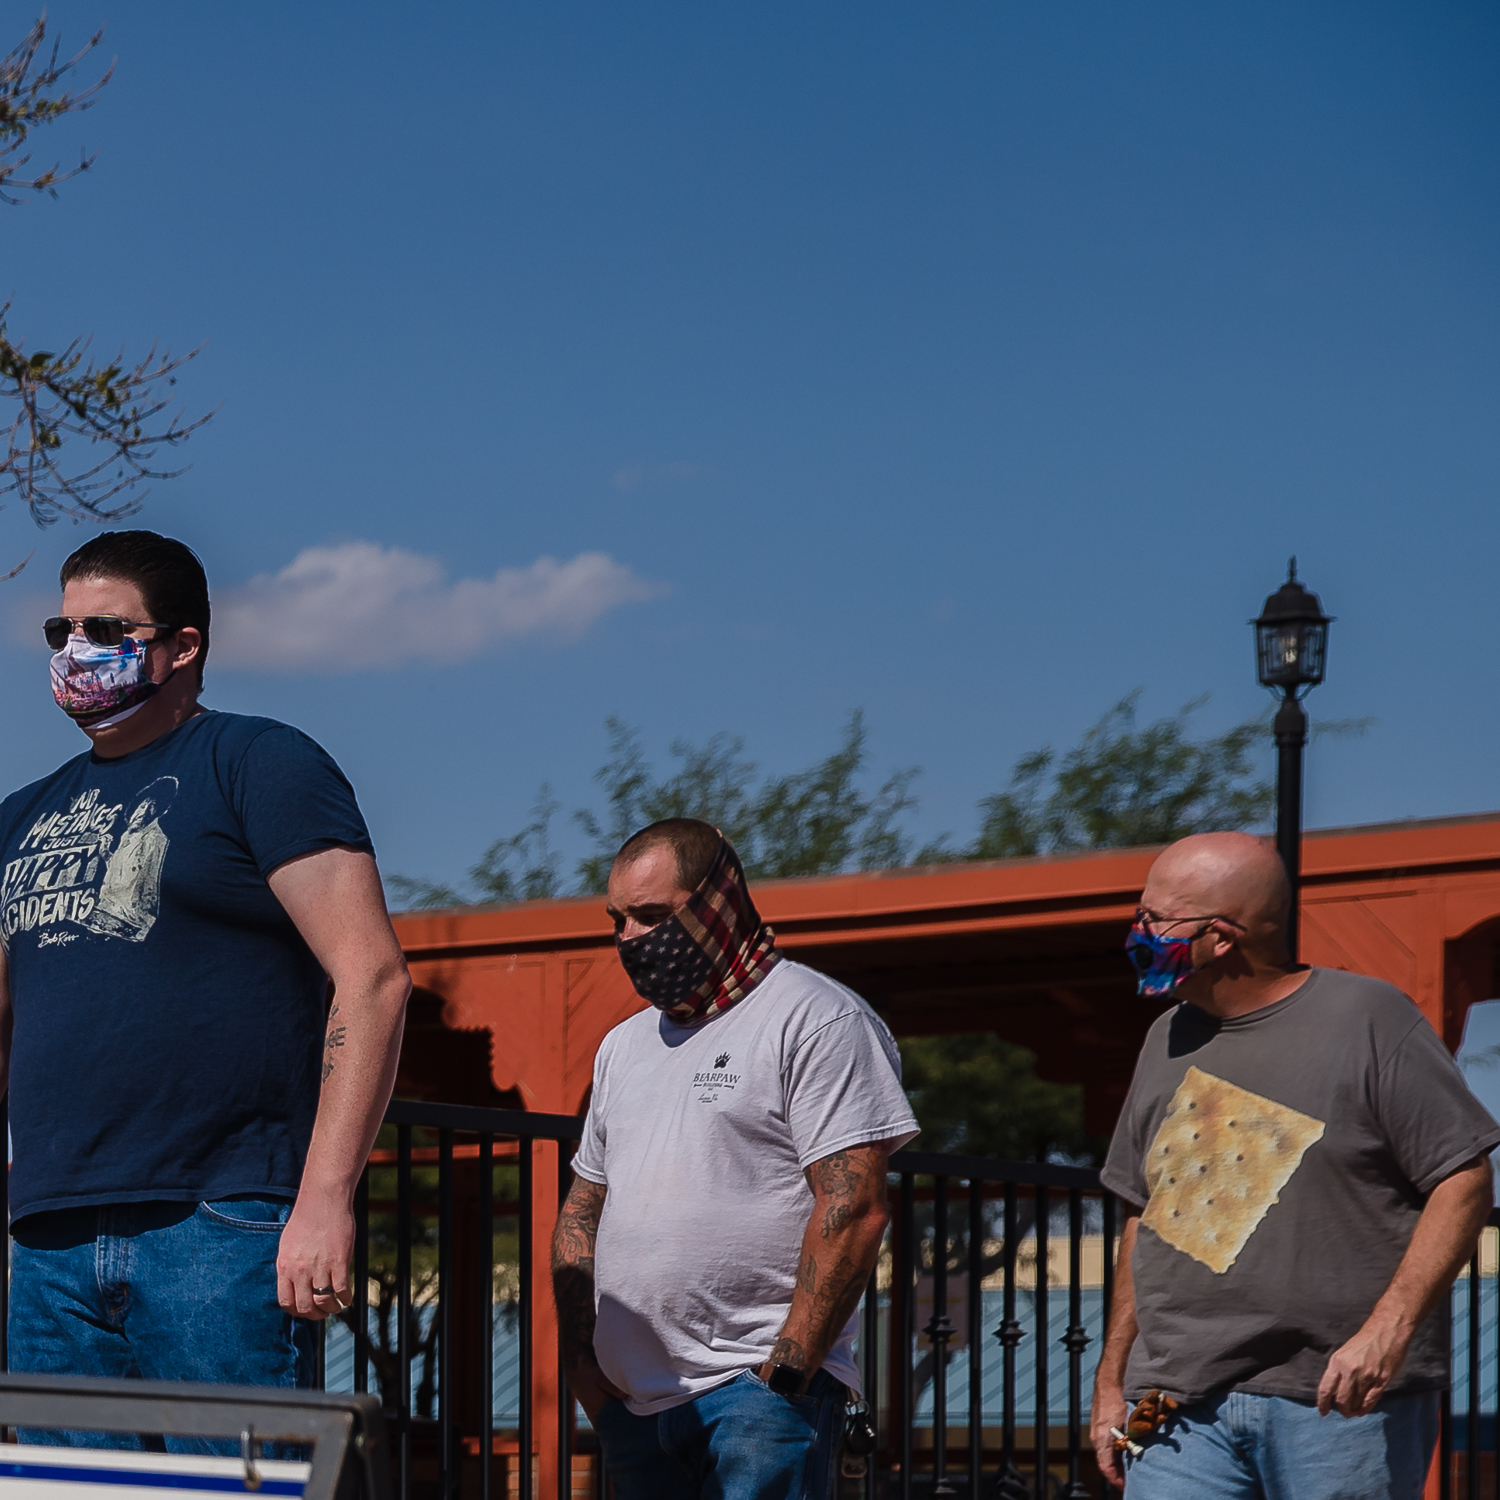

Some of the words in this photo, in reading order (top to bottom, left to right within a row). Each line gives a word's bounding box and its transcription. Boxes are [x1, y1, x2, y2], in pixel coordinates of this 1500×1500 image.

[70, 788, 100, 814] NO
[19, 803, 123, 850] MISTAKES
[42, 834, 81, 850] JUST
[1, 846, 99, 907] HAPPY
[693, 1073, 741, 1083] BEARPAW
